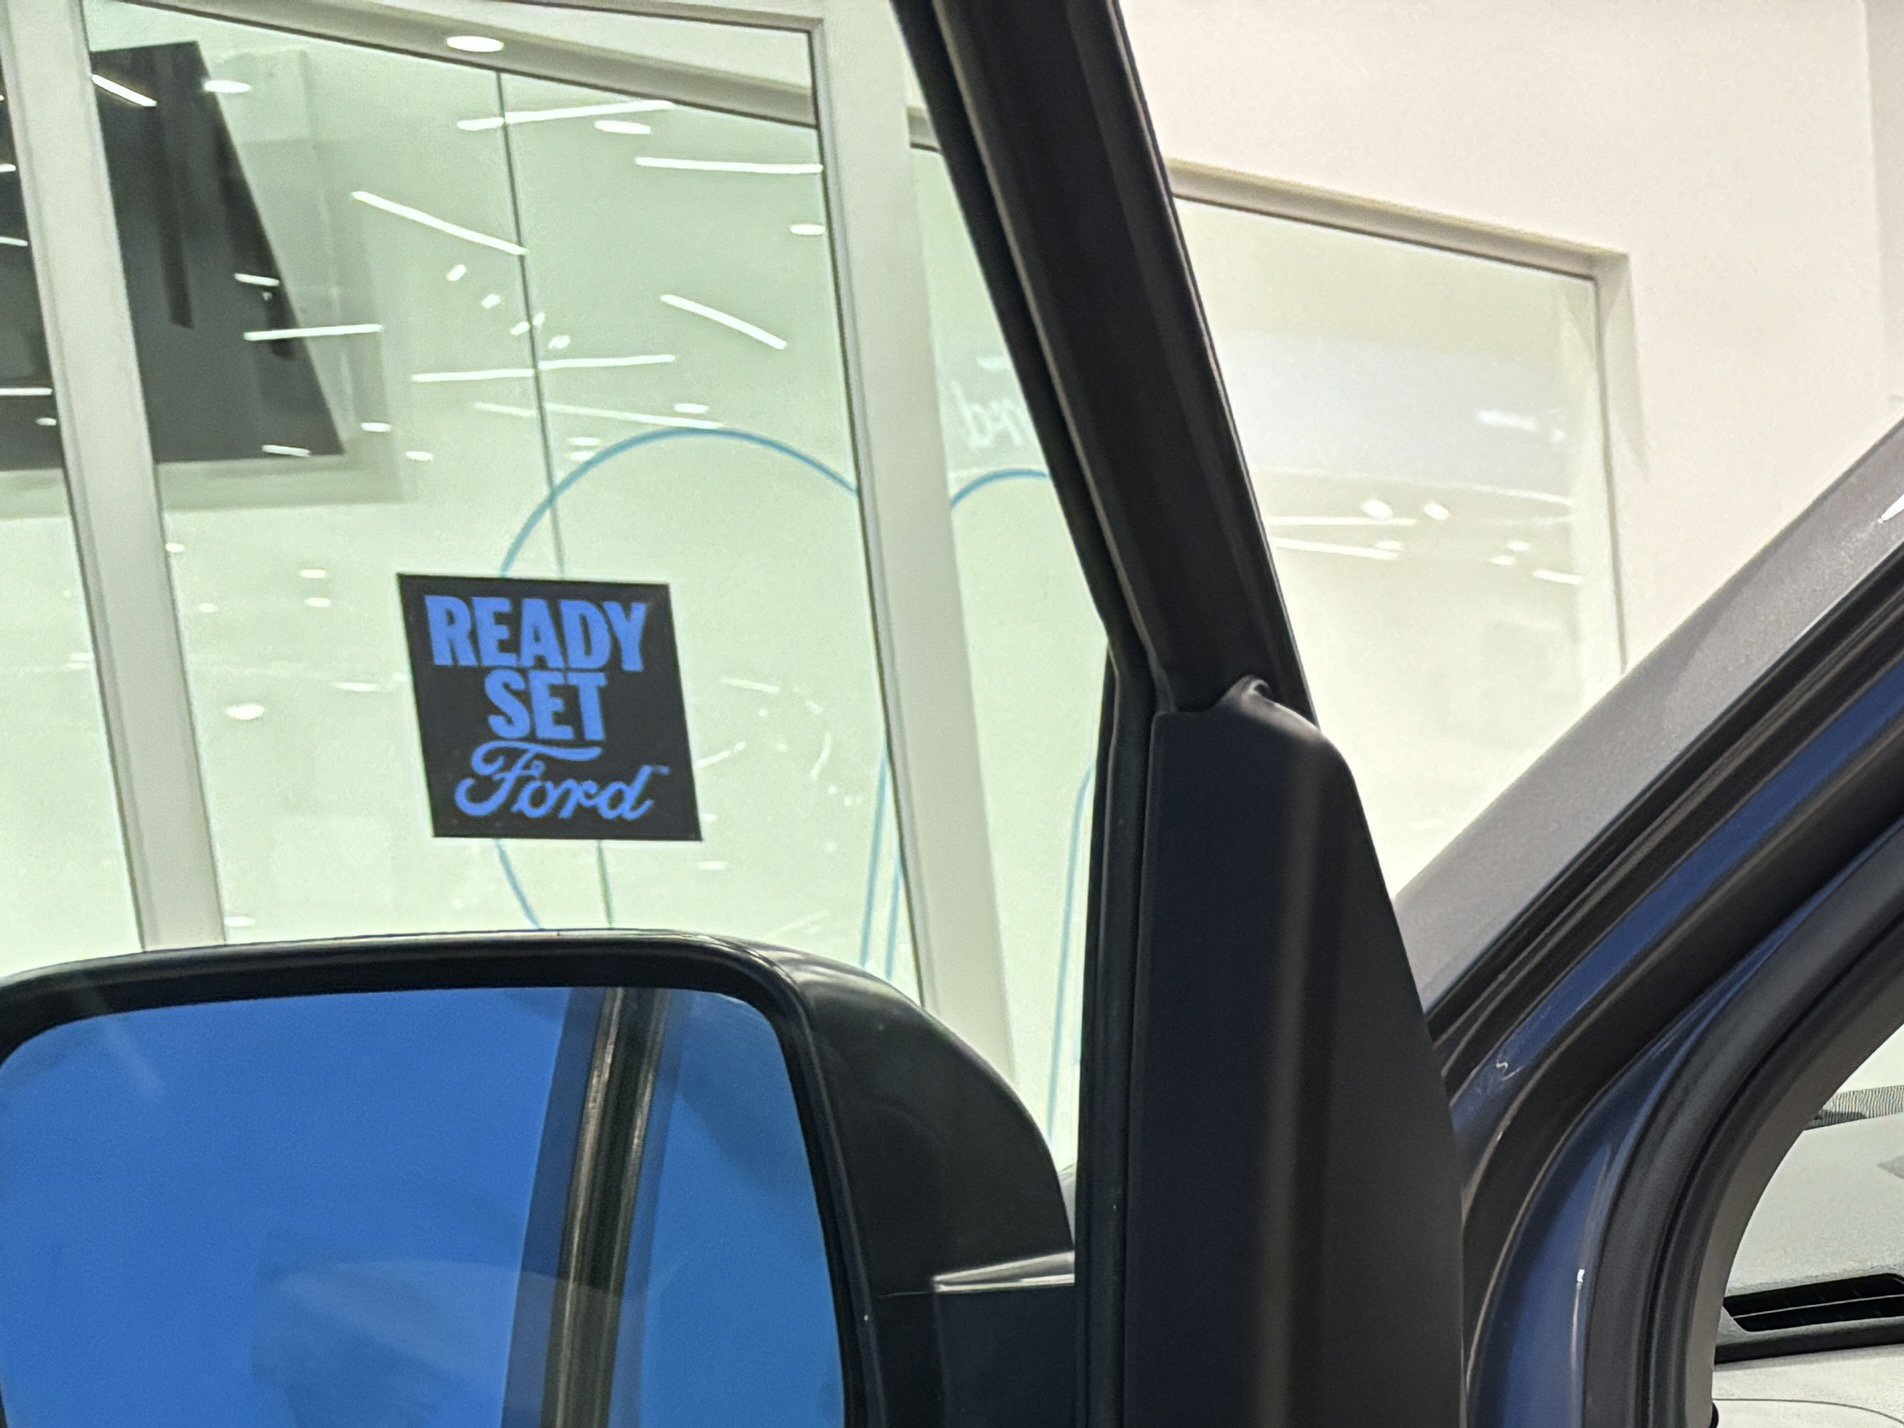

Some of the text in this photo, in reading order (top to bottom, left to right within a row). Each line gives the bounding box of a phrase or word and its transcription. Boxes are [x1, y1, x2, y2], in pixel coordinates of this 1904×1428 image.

[424, 594, 648, 672] READY
[484, 668, 608, 742] SET
[454, 740, 671, 821] Ford
